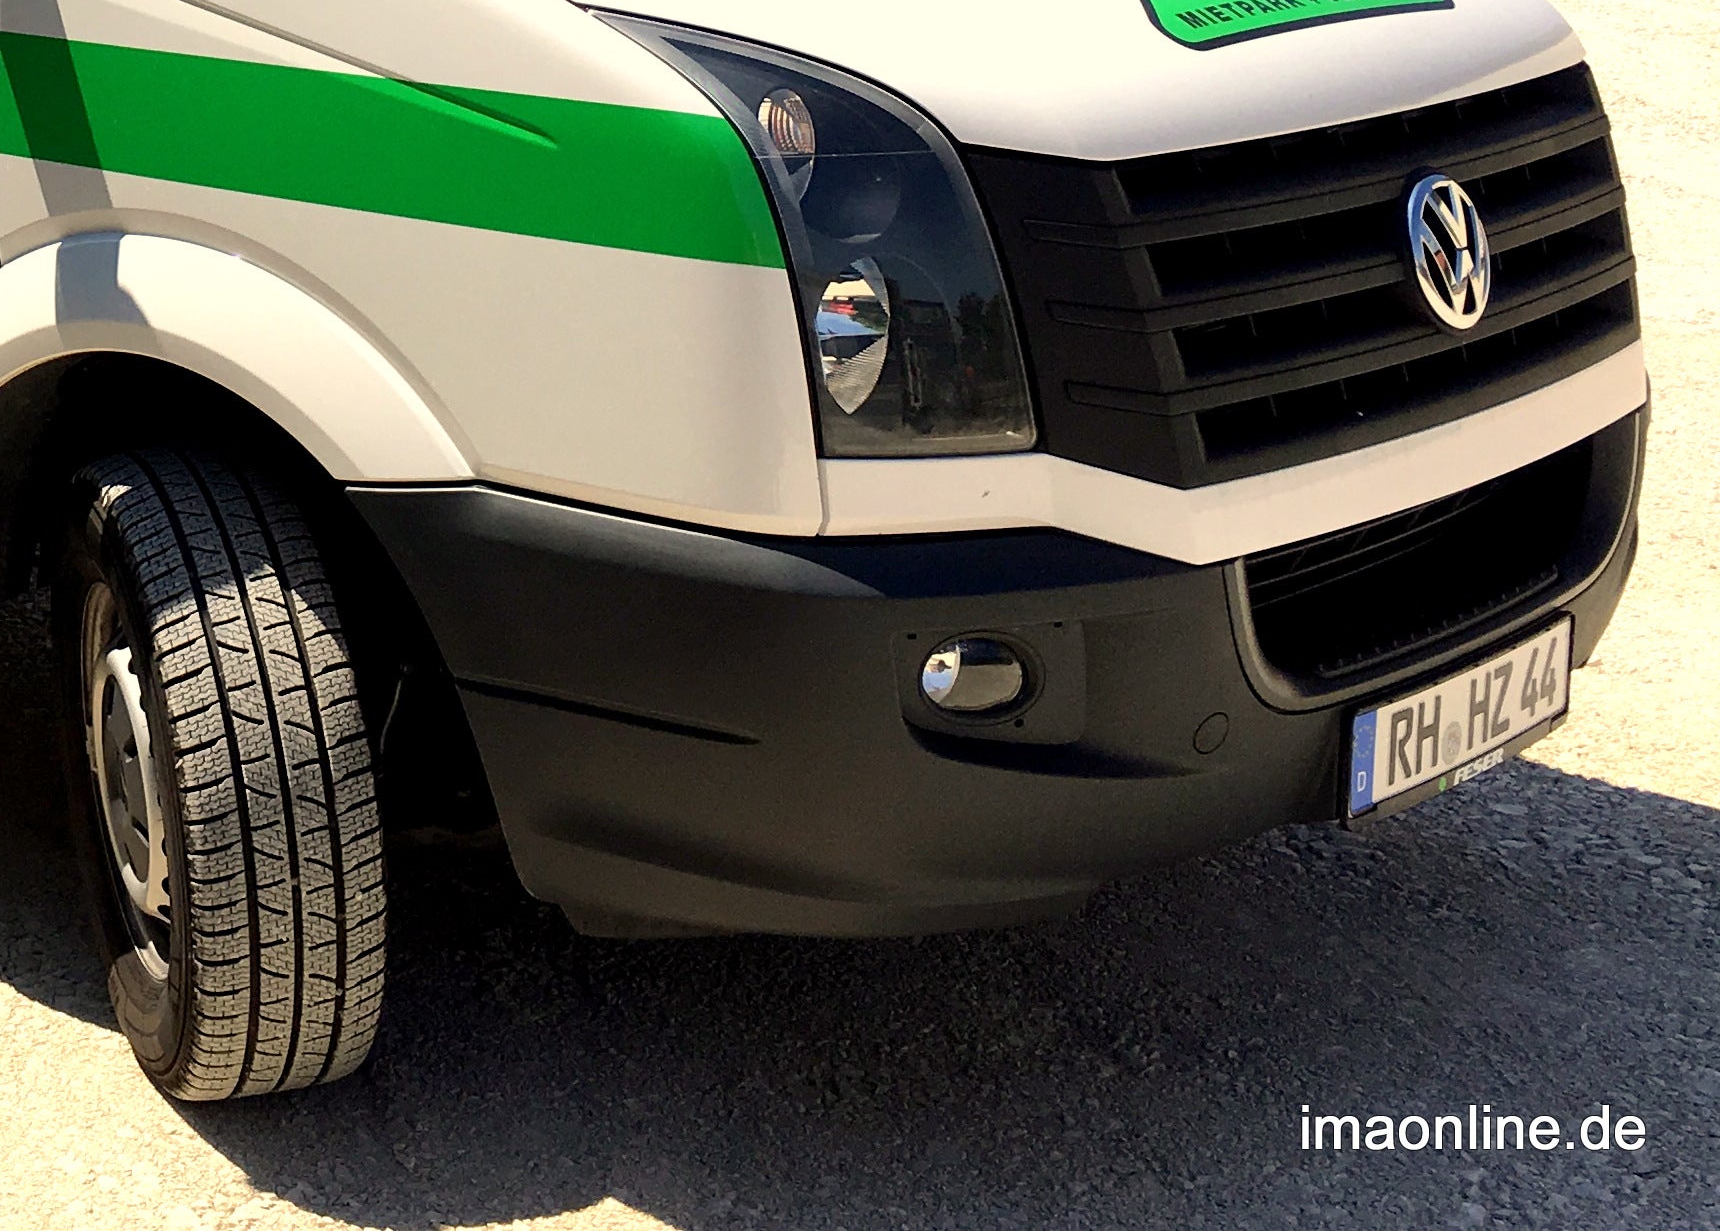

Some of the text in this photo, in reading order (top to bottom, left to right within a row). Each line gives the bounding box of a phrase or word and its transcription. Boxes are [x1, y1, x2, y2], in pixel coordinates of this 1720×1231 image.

[1388, 695, 1441, 787] RH
[1467, 660, 1513, 751] HZ
[1520, 636, 1557, 717] 44
[1453, 748, 1504, 787] FESER
